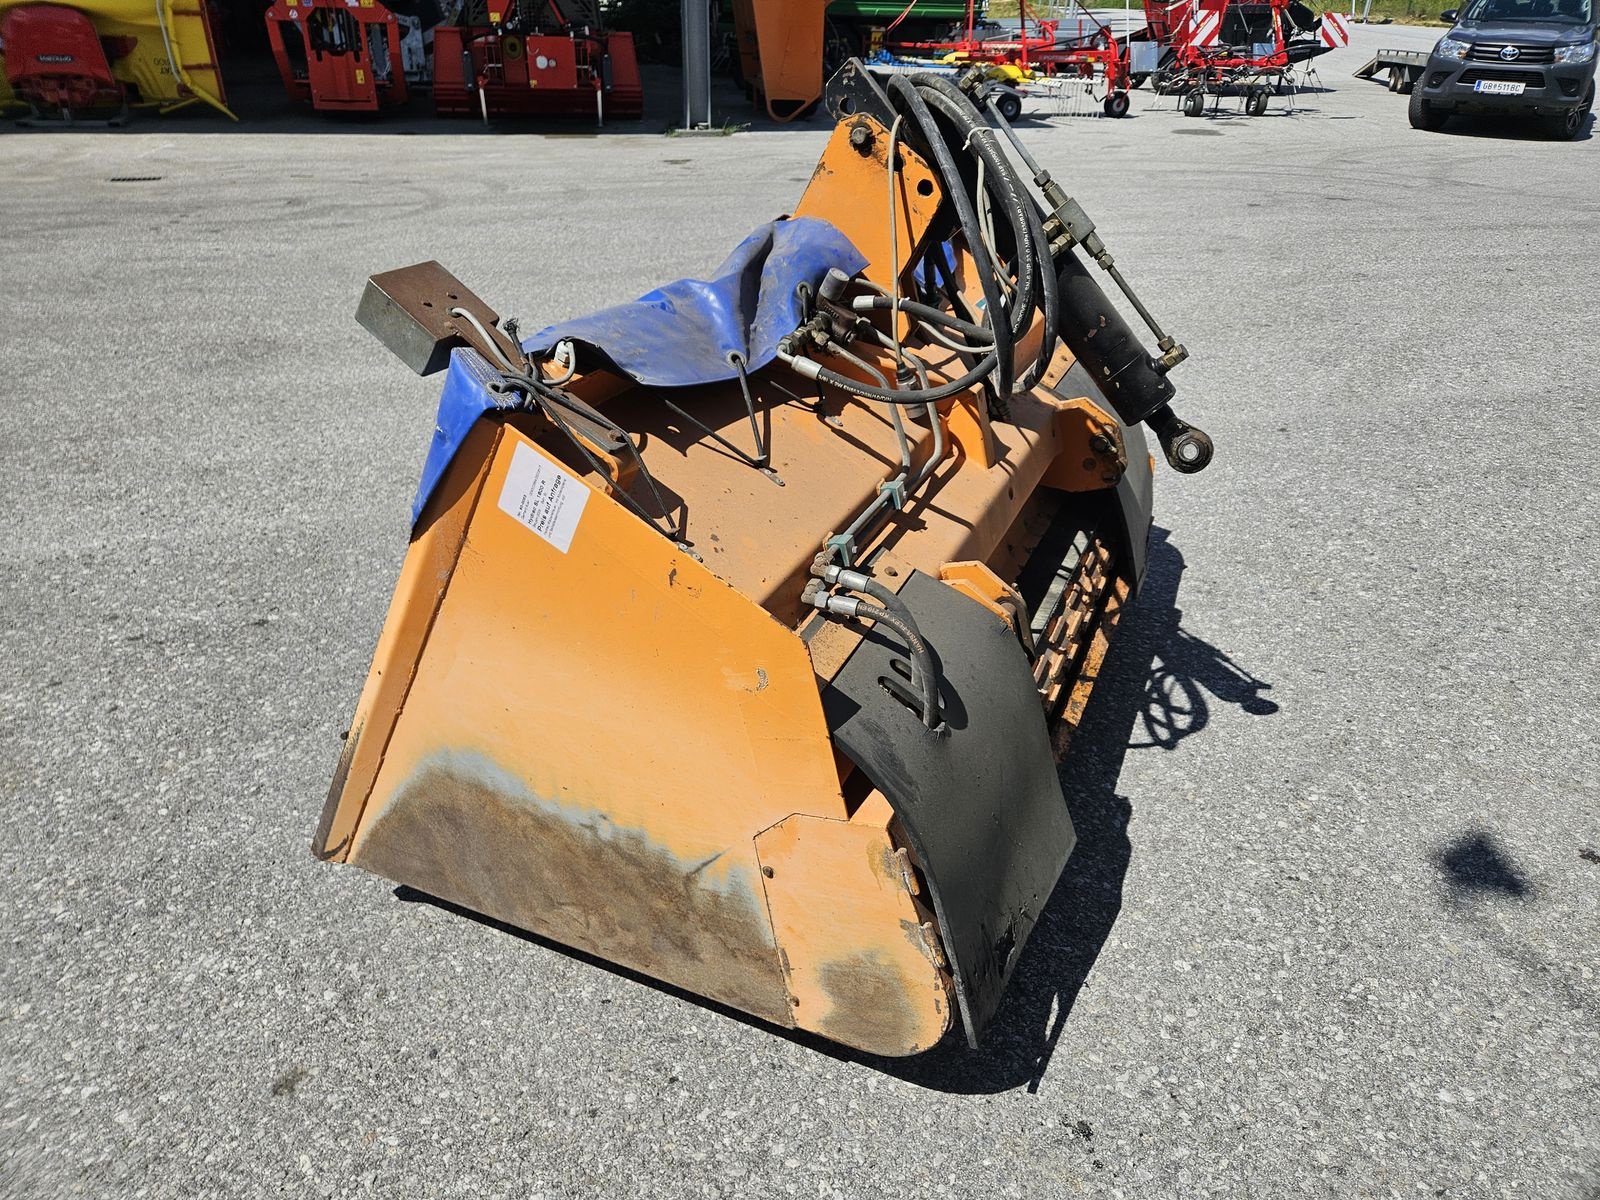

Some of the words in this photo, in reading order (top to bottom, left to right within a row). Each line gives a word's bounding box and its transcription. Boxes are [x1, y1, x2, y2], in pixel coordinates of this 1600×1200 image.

[537, 514, 547, 532] Preis
[543, 501, 552, 515] auf
[548, 474, 562, 502] Anfrage
[890, 616, 925, 654] HANSA-FLEX
